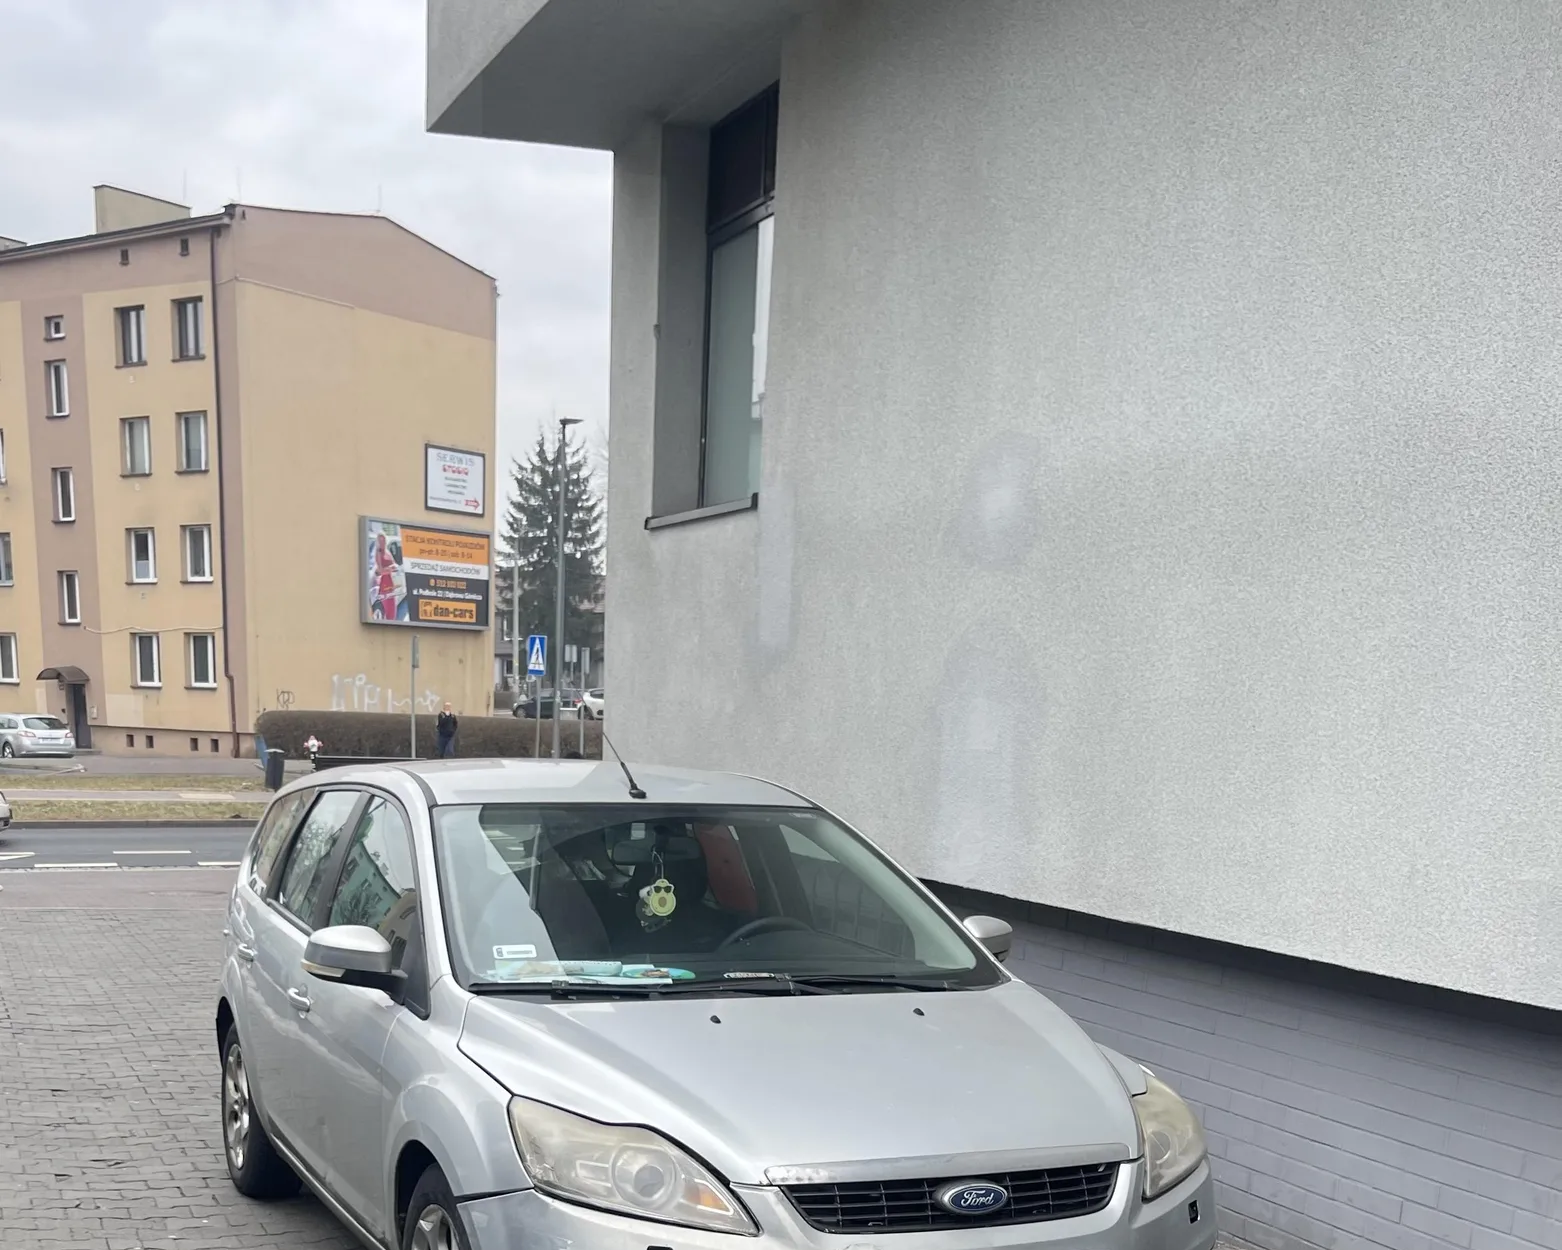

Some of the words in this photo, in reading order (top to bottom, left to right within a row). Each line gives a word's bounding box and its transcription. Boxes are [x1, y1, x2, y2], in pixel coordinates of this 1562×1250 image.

[436, 452, 475, 467] SERWIS
[440, 565, 480, 575] SAMOCHODÓW
[433, 604, 474, 619] dan-cars
[960, 1189, 995, 1207] Ford
